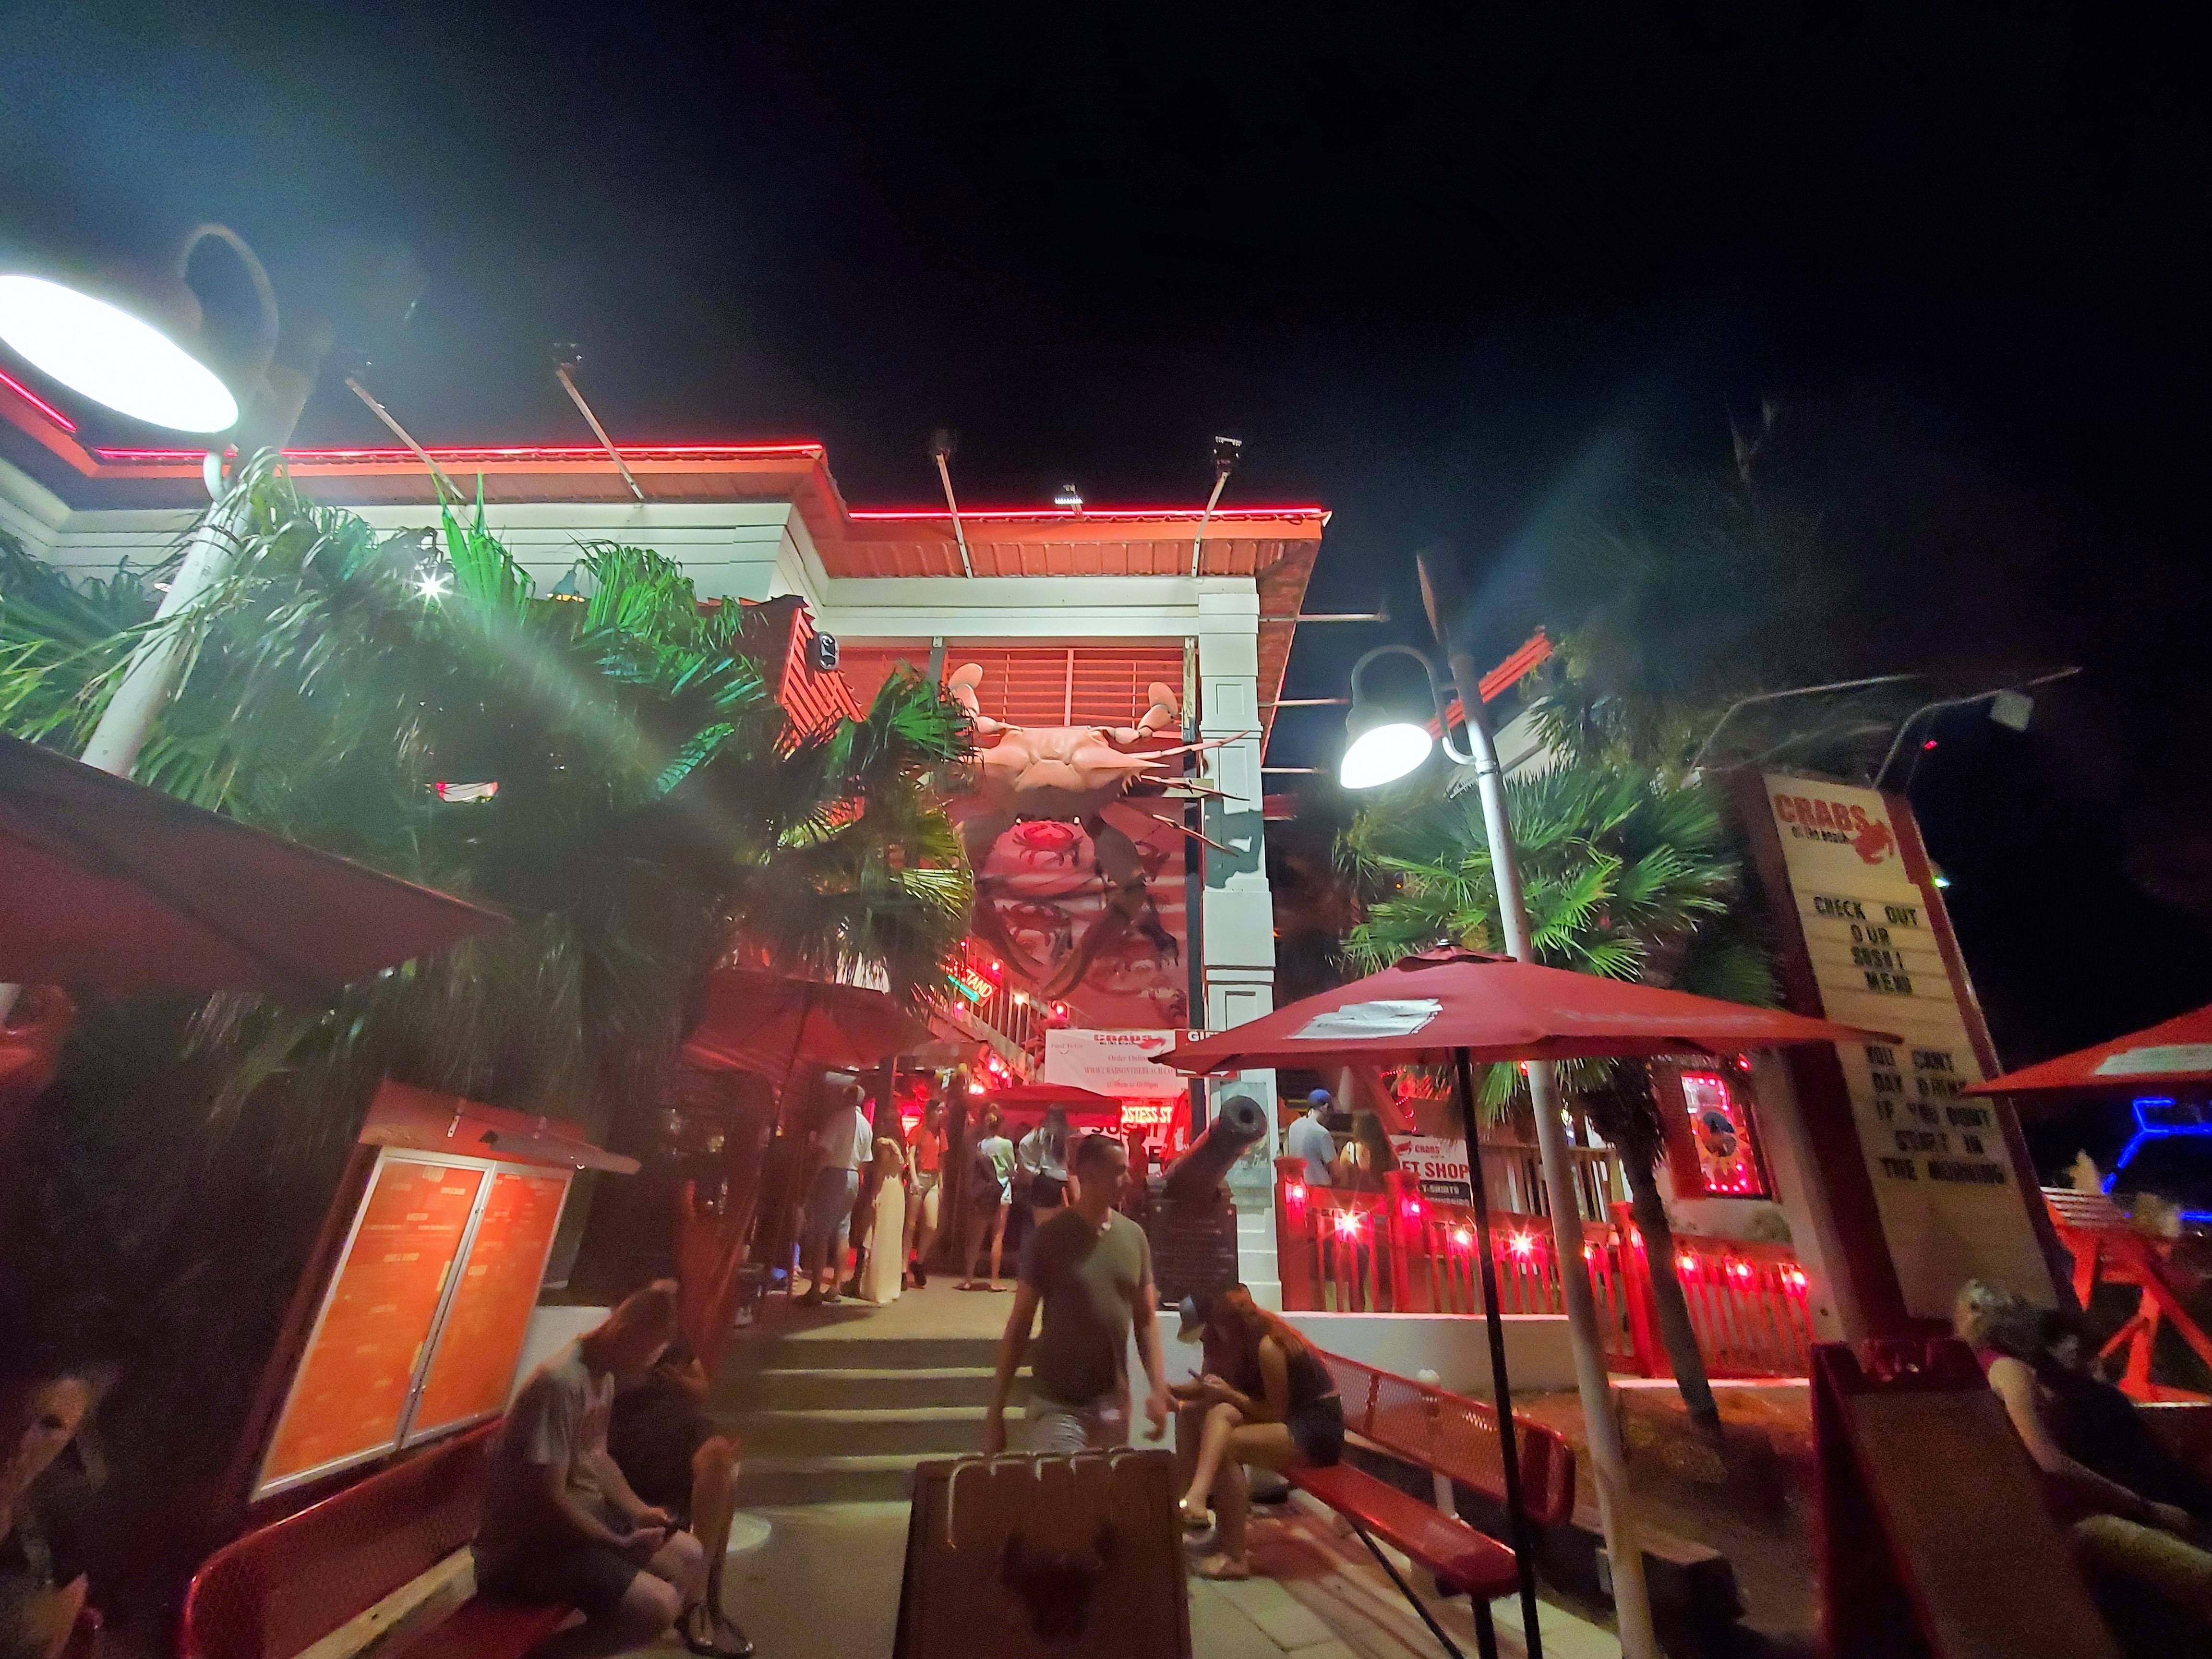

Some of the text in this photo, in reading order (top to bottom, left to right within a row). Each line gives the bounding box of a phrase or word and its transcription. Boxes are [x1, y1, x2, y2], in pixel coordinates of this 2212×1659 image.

[1774, 794, 1870, 831] CRABS
[1814, 896, 1917, 926] CHECK OUT
[1851, 924, 1890, 946] OUR
[961, 968, 993, 998] TAND
[1188, 1031, 1219, 1042] GIF
[1425, 1163, 1469, 1178] SHOP
